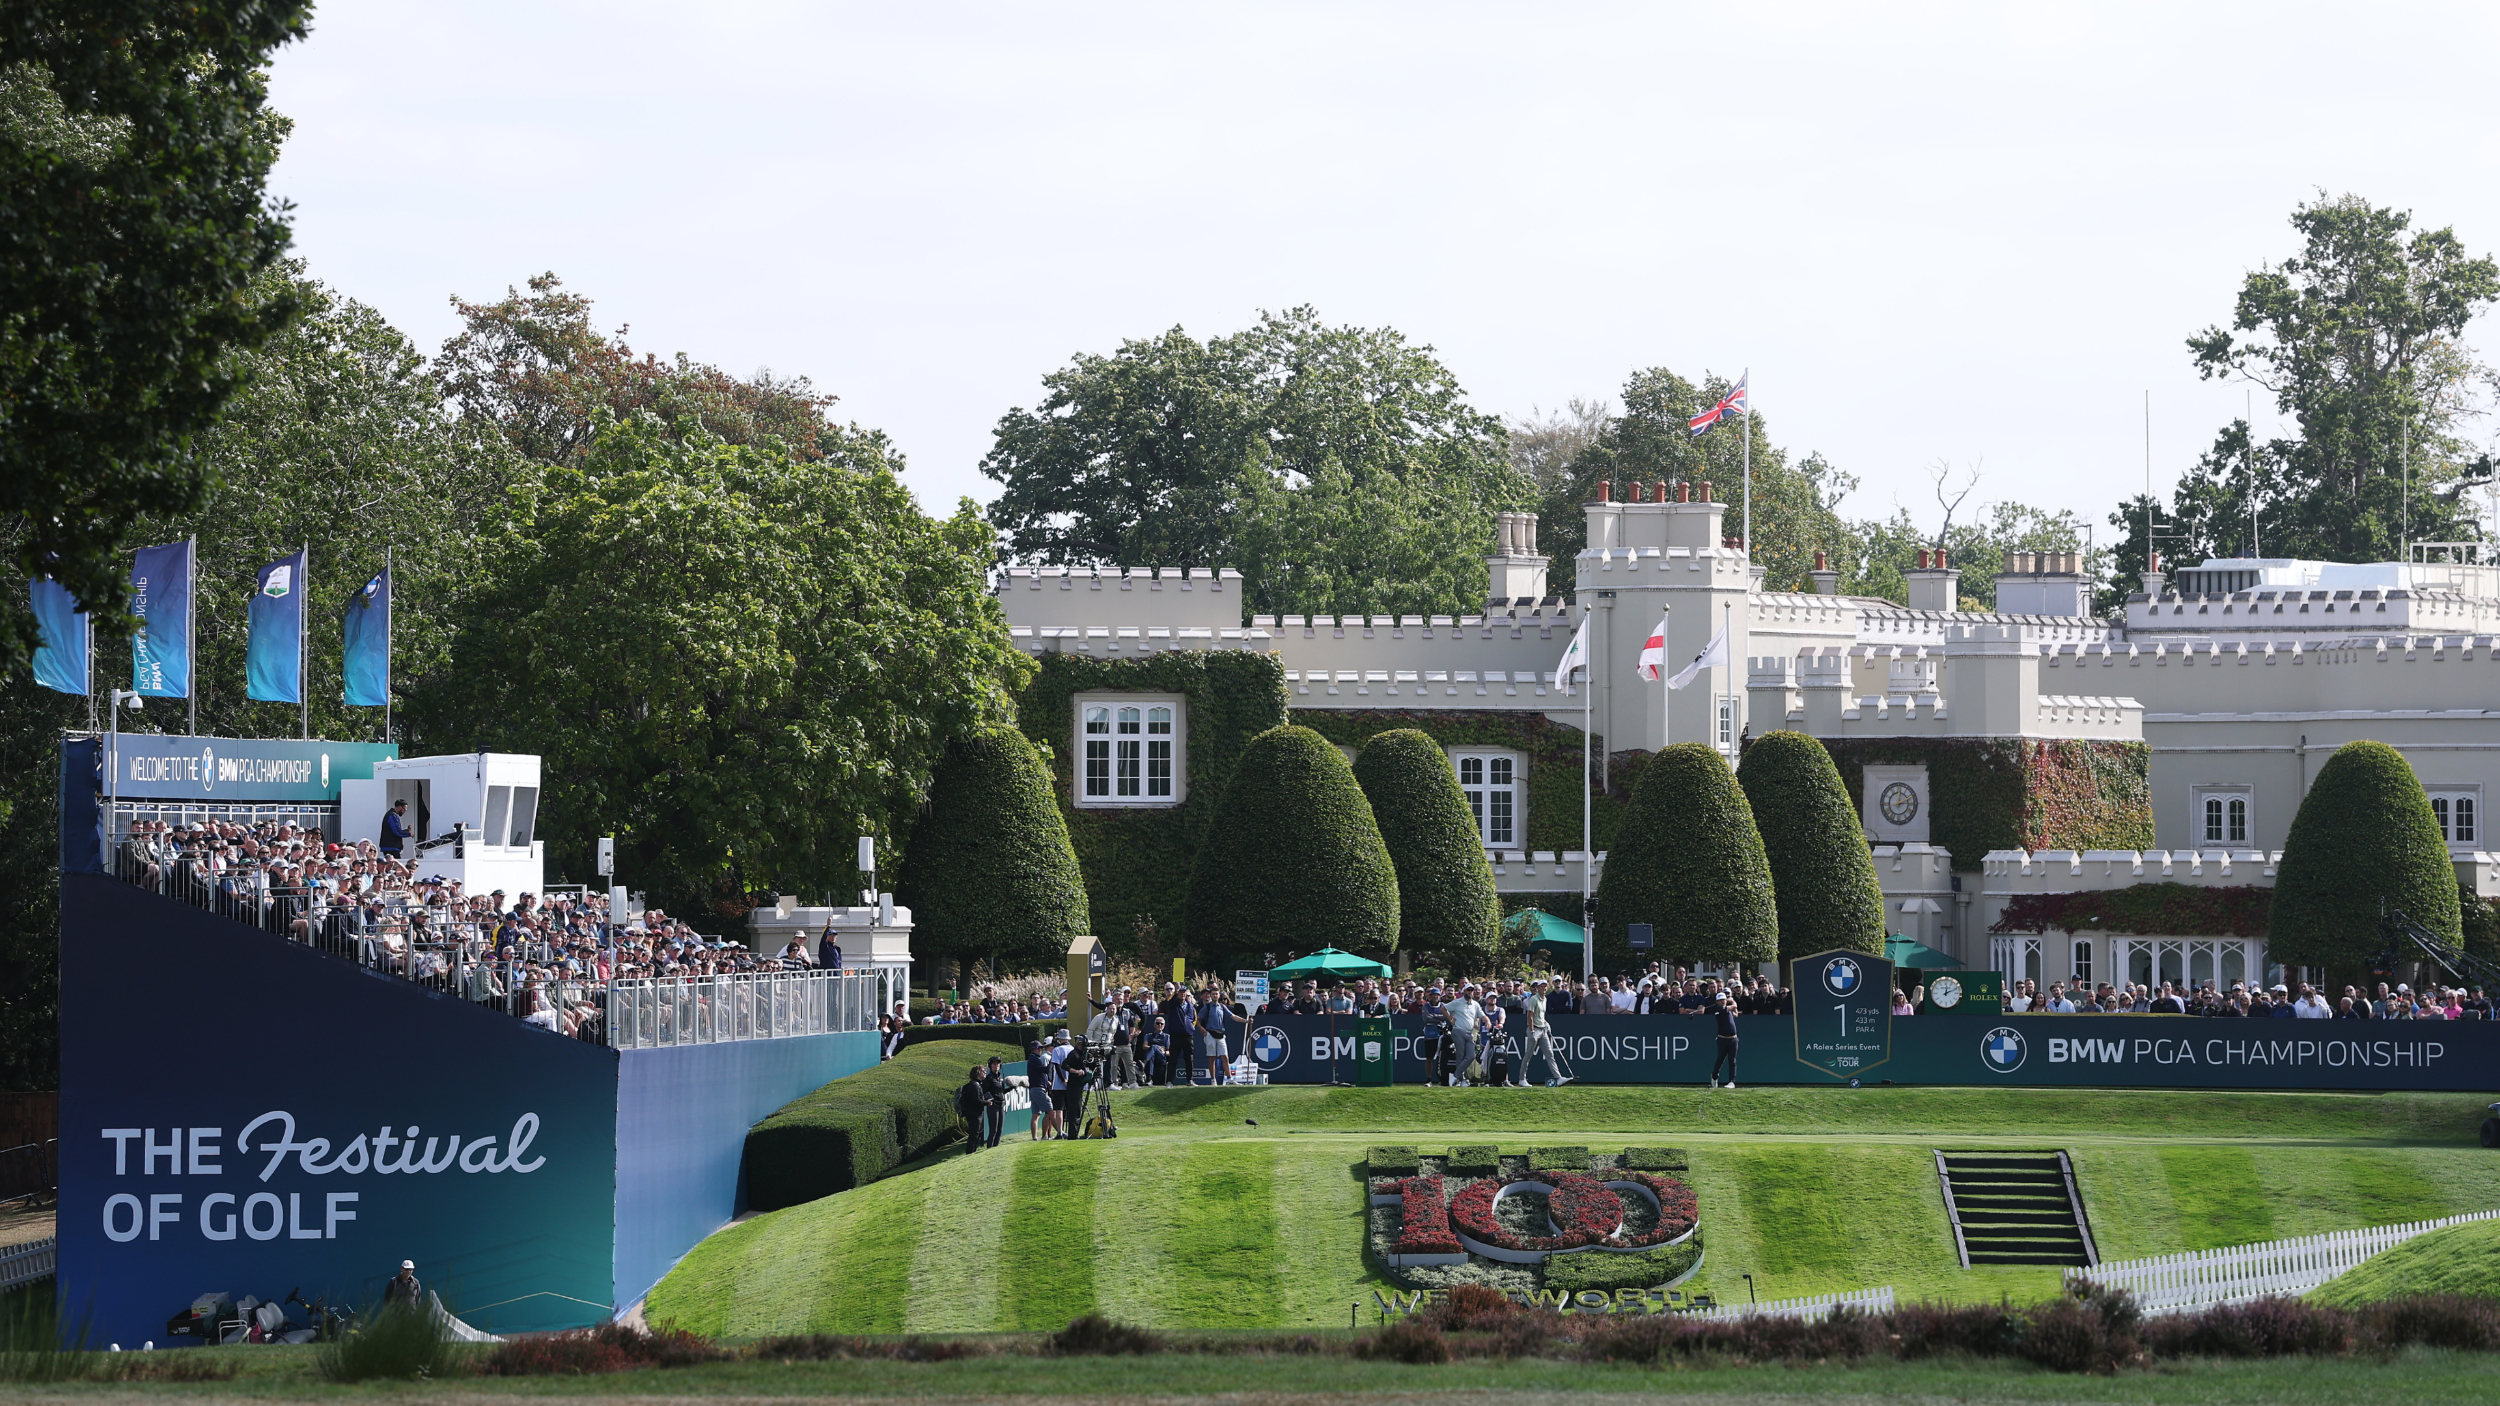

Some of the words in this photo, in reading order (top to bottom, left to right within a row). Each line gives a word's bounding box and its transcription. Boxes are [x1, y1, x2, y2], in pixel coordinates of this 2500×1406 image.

[130, 756, 170, 781] WELCOME
[171, 756, 182, 781] TO
[183, 756, 199, 781] THE
[219, 758, 238, 782] BMW
[239, 758, 254, 783] PGA
[255, 758, 312, 784] CHAMPIONSHIP
[1828, 959, 1857, 971] BMW
[1833, 1003, 1846, 1037] 1
[1868, 1008, 1880, 1016] yds
[1252, 1028, 1285, 1041] BMW
[1805, 1043, 1812, 1051] A
[1813, 1043, 1834, 1051] Rolex
[1835, 1043, 1858, 1051] Series
[1859, 1043, 1880, 1051] Event
[1987, 1029, 2021, 1042] BMW
[1311, 1036, 1356, 1060] BM
[2048, 1037, 2125, 1064] BMW
[2134, 1038, 2197, 1065] PGA
[2205, 1039, 2445, 1068] CHAMPIONSHIP
[101, 1127, 223, 1176] THE
[237, 1110, 547, 1182] Festival
[102, 1193, 183, 1242] OF
[200, 1191, 359, 1241] GOLF
[1373, 1167, 1700, 1265] 100
